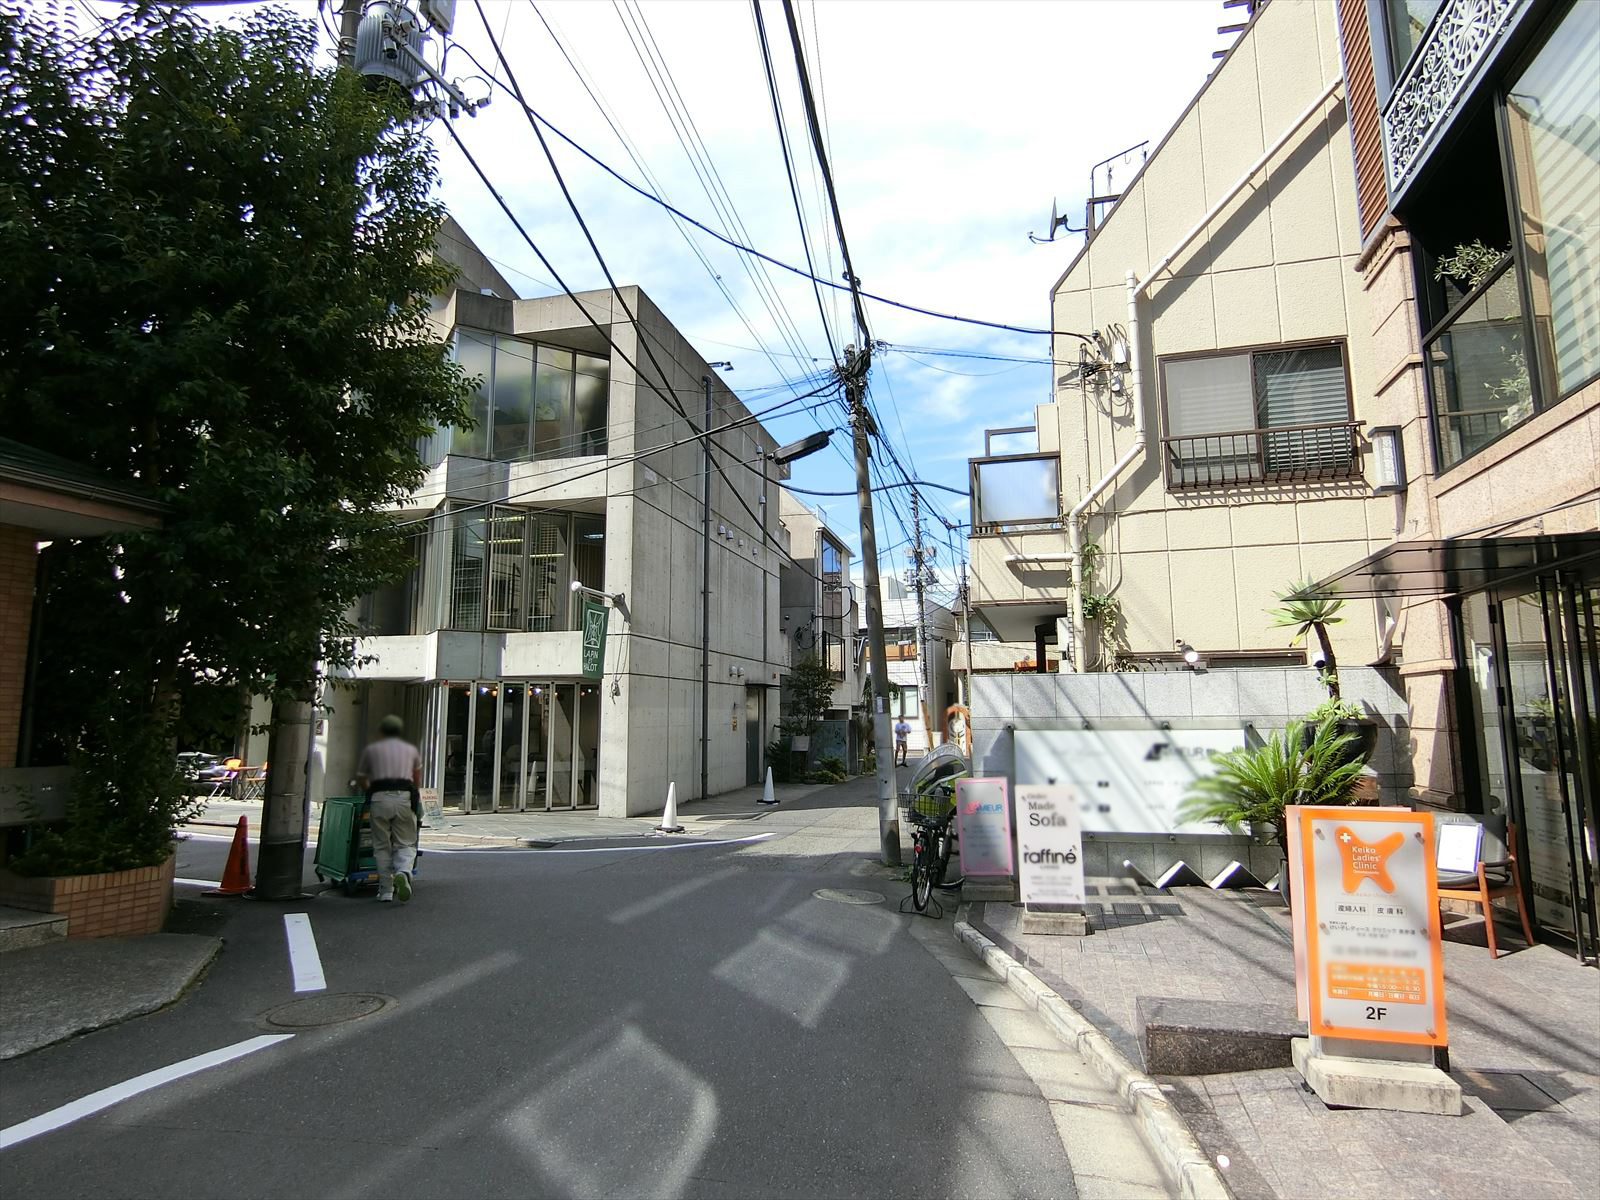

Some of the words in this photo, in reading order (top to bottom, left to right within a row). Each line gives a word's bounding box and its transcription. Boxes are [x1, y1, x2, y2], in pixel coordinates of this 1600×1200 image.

[1028, 802, 1055, 811] Made
[1029, 813, 1067, 828] Sofa
[1352, 846, 1376, 854] Keiko
[1024, 849, 1077, 865] raffiné
[1352, 862, 1377, 870] Clinic
[1338, 905, 1366, 913] 産婦人科
[1377, 907, 1403, 915] 皮膚科
[1366, 1006, 1387, 1020] 2F
